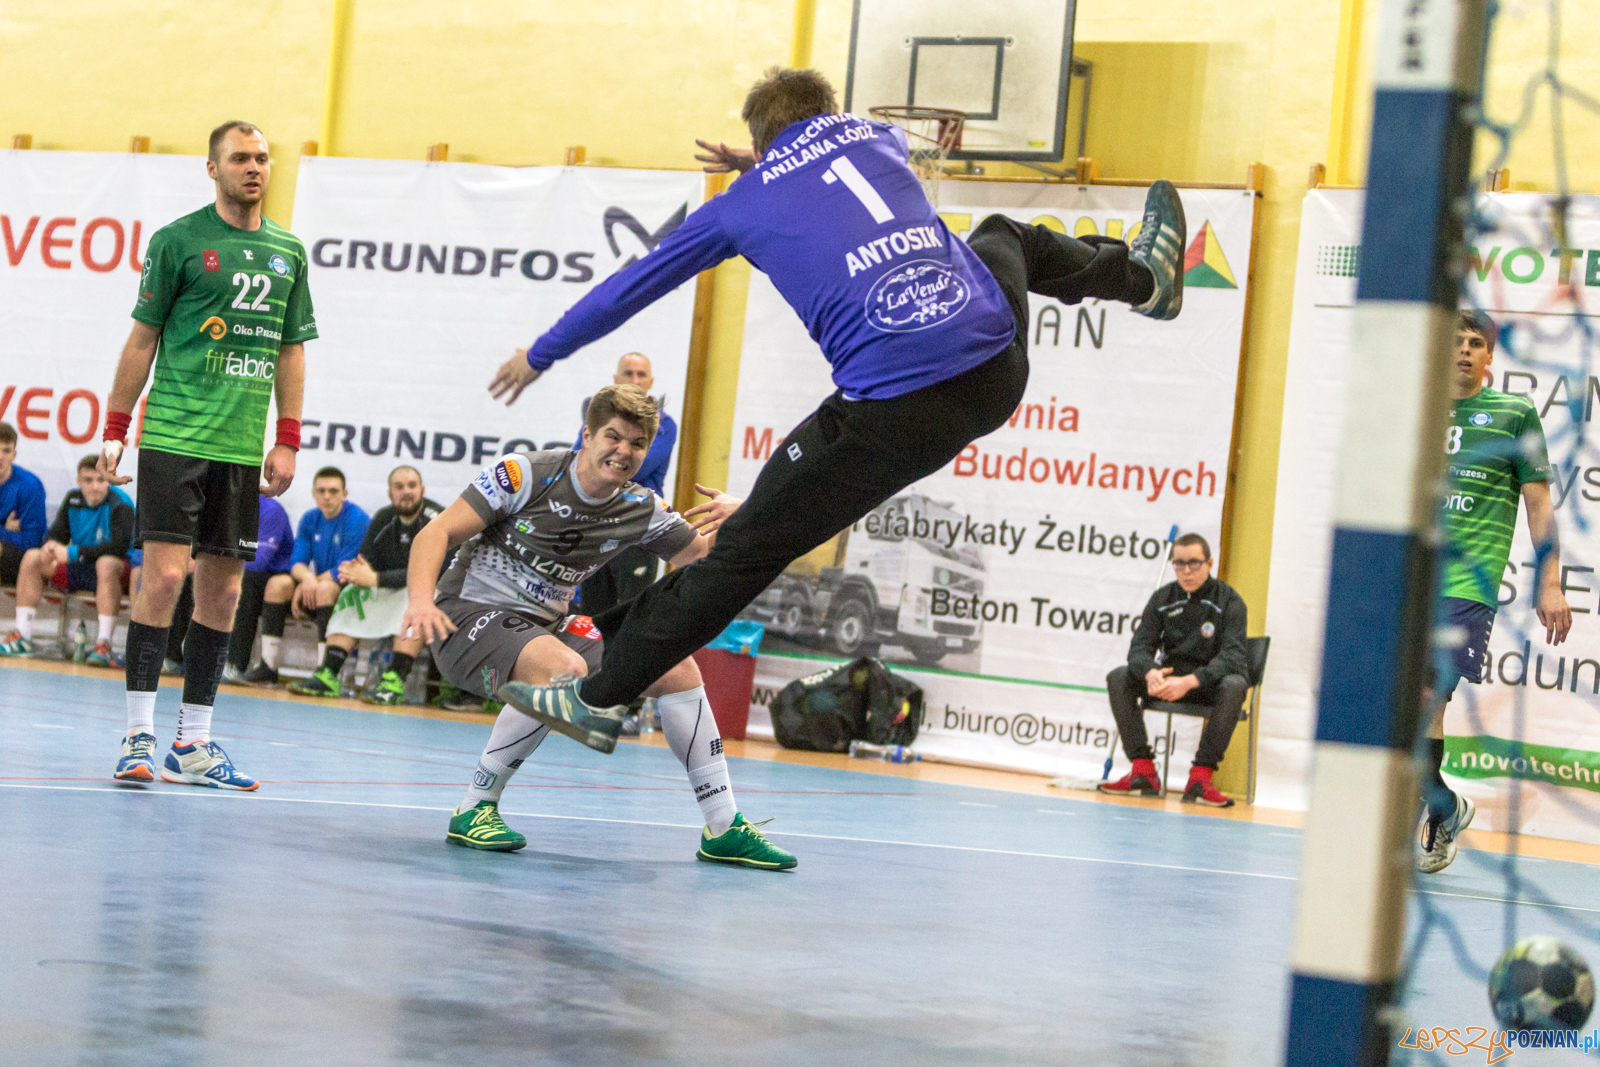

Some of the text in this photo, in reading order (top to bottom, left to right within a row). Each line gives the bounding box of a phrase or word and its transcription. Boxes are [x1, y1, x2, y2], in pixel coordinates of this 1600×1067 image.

[762, 139, 838, 184] ANILANA
[821, 155, 895, 224] 1
[311, 238, 595, 283] GRUNDFOS
[845, 226, 943, 278] ANTOSIK
[231, 272, 271, 312] 22
[233, 324, 253, 336] Oko
[497, 467, 510, 487] UNO
[953, 444, 1217, 503] Budowlanych
[930, 587, 1019, 624] Beton
